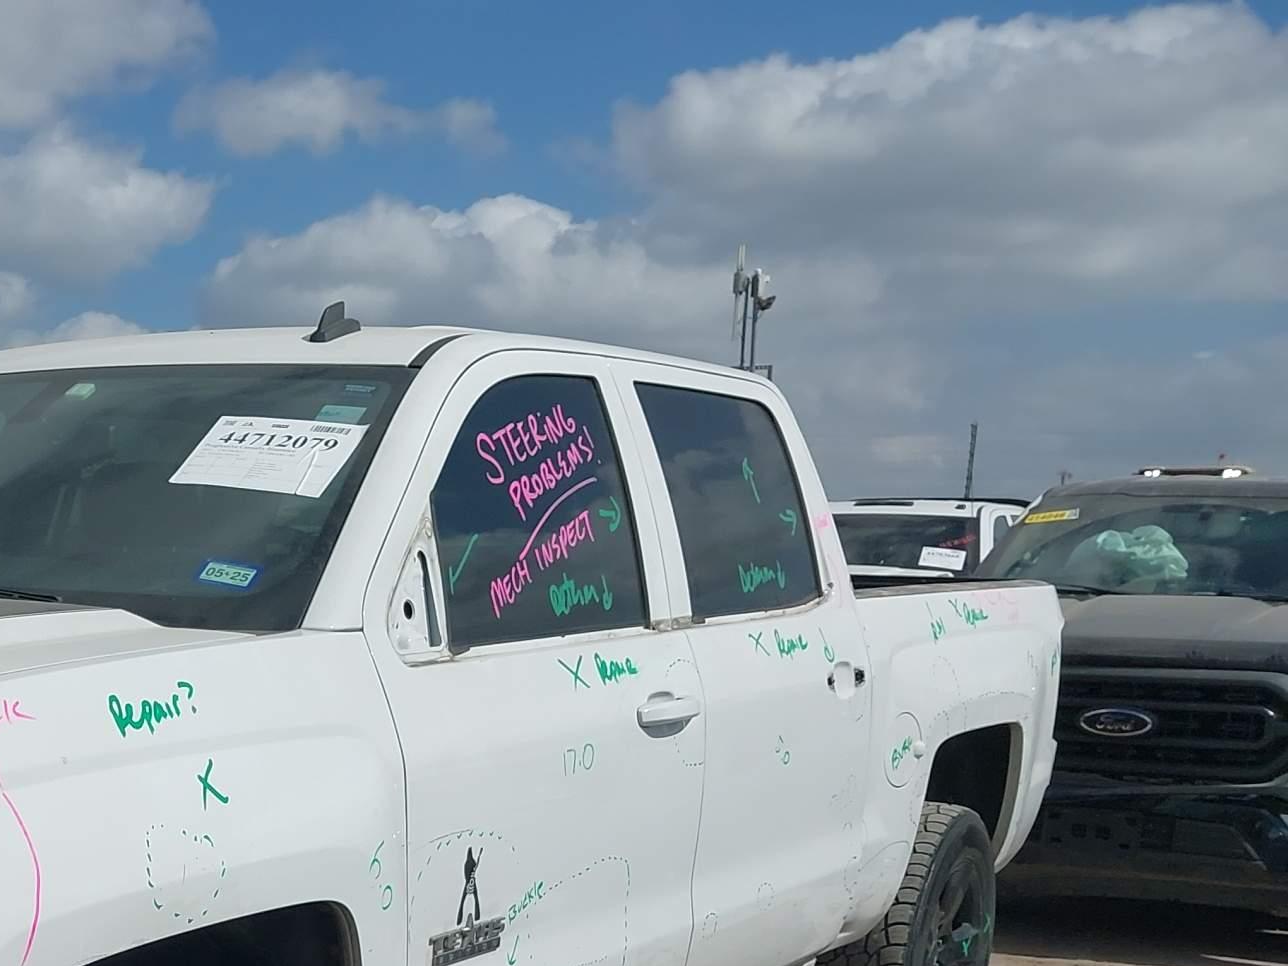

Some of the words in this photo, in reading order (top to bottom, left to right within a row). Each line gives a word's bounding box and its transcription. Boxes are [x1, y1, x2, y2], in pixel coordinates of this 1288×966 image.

[218, 431, 339, 451] 44712079
[476, 404, 576, 485] STEERING
[490, 559, 533, 619] MECH
[534, 509, 595, 571] INSPECT
[428, 913, 506, 956] TEXAS
